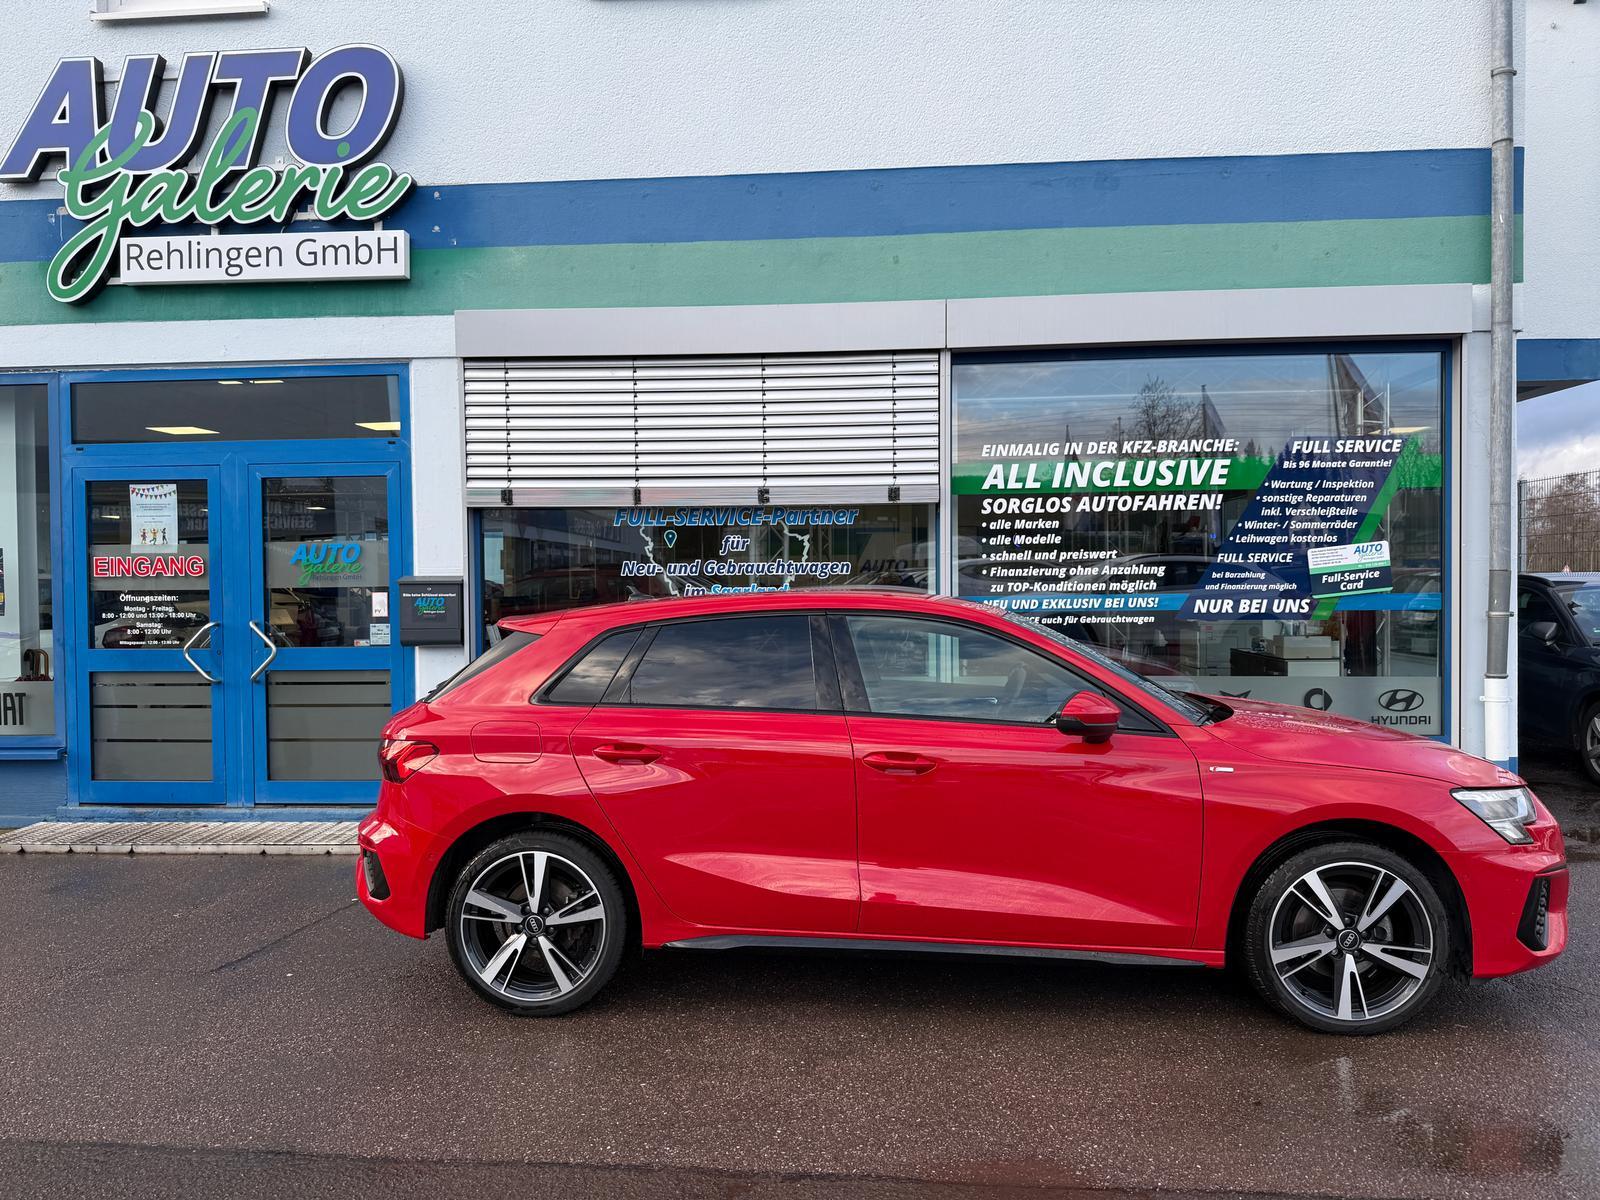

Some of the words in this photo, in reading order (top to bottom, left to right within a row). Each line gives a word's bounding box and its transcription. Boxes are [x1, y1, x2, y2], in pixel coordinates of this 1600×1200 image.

[0, 43, 402, 179] AUTO
[126, 240, 283, 276] Rehlingen
[295, 236, 399, 267] GmbH
[981, 442, 1060, 457] EINMALIG
[1064, 442, 1083, 455] IN
[1086, 440, 1118, 455] DER
[1121, 439, 1240, 454] KFZ-BRANCHE:
[1292, 440, 1331, 454] FULL
[1334, 439, 1402, 453] SERVICE
[1283, 460, 1297, 469] Bis
[1298, 460, 1310, 468] 96
[1312, 460, 1347, 468] Monate
[1349, 459, 1392, 468] Garantie!
[981, 463, 1042, 490] ALL
[1051, 459, 1231, 488] INCLUSIVE
[1270, 480, 1313, 491] Wartung
[1322, 479, 1375, 491] Inspektion
[981, 497, 1072, 515] SORGLOS
[1075, 494, 1223, 513] AUTOFAHREN!
[1262, 494, 1303, 505] sonstige
[1305, 493, 1367, 504] Reparaturen
[613, 506, 859, 527] FULL-SERVICE-Partner
[1261, 508, 1282, 516] inkl.
[1285, 507, 1358, 518] Verschleißteile
[989, 519, 1012, 530] alle
[1014, 519, 1060, 530] Marken
[1244, 521, 1281, 530] Winter-
[1289, 520, 1358, 530] Sommerräder
[719, 534, 751, 555] für
[989, 535, 1012, 545] alle
[1014, 533, 1062, 545] Modelle
[1235, 534, 1289, 544] Leihwagen
[1290, 534, 1338, 543] kostenlos
[290, 543, 361, 565] AUTO
[989, 550, 1032, 561] schnell
[1034, 550, 1057, 560] und
[1059, 549, 1118, 562] preiswert
[1354, 543, 1383, 555] AUTO
[1217, 553, 1245, 563] FULL
[1246, 552, 1294, 563] SERVICE
[93, 556, 204, 578] EINGANG
[621, 561, 663, 577] Neu-
[667, 560, 701, 577] und
[703, 559, 852, 579] Gebrauchtwagen
[860, 559, 909, 572] AUTO
[989, 566, 1067, 578] Finanzierung
[1069, 565, 1099, 576] ohne
[1101, 564, 1166, 577] Anzahlung
[1211, 571, 1224, 579] bei
[1224, 571, 1266, 580] Barzahlung
[1322, 569, 1380, 584] Full-Service
[684, 583, 707, 598] im
[990, 583, 1004, 593] zu
[1007, 581, 1106, 593] TOP-Konditionen
[1108, 580, 1157, 593] möglich
[1220, 583, 1267, 591] Finanzierung
[1268, 582, 1297, 591] möglich
[1340, 580, 1364, 591] Card
[119, 593, 179, 603] Öffnungszeiten:
[415, 597, 445, 606] AUTO
[1011, 599, 1039, 610] UND
[1042, 598, 1102, 609] EXKLUSIV
[1104, 598, 1124, 609] BEI
[1128, 597, 1159, 608] UNS!
[124, 605, 146, 613] Montag
[1193, 599, 1234, 614] NUR
[1238, 599, 1268, 614] BEI
[1272, 598, 1311, 614] UNS
[1041, 615, 1063, 625] auch
[1064, 615, 1079, 626] für
[1080, 615, 1155, 625] Gebrauchtwagen
[1371, 715, 1431, 725] HYUNDAI
